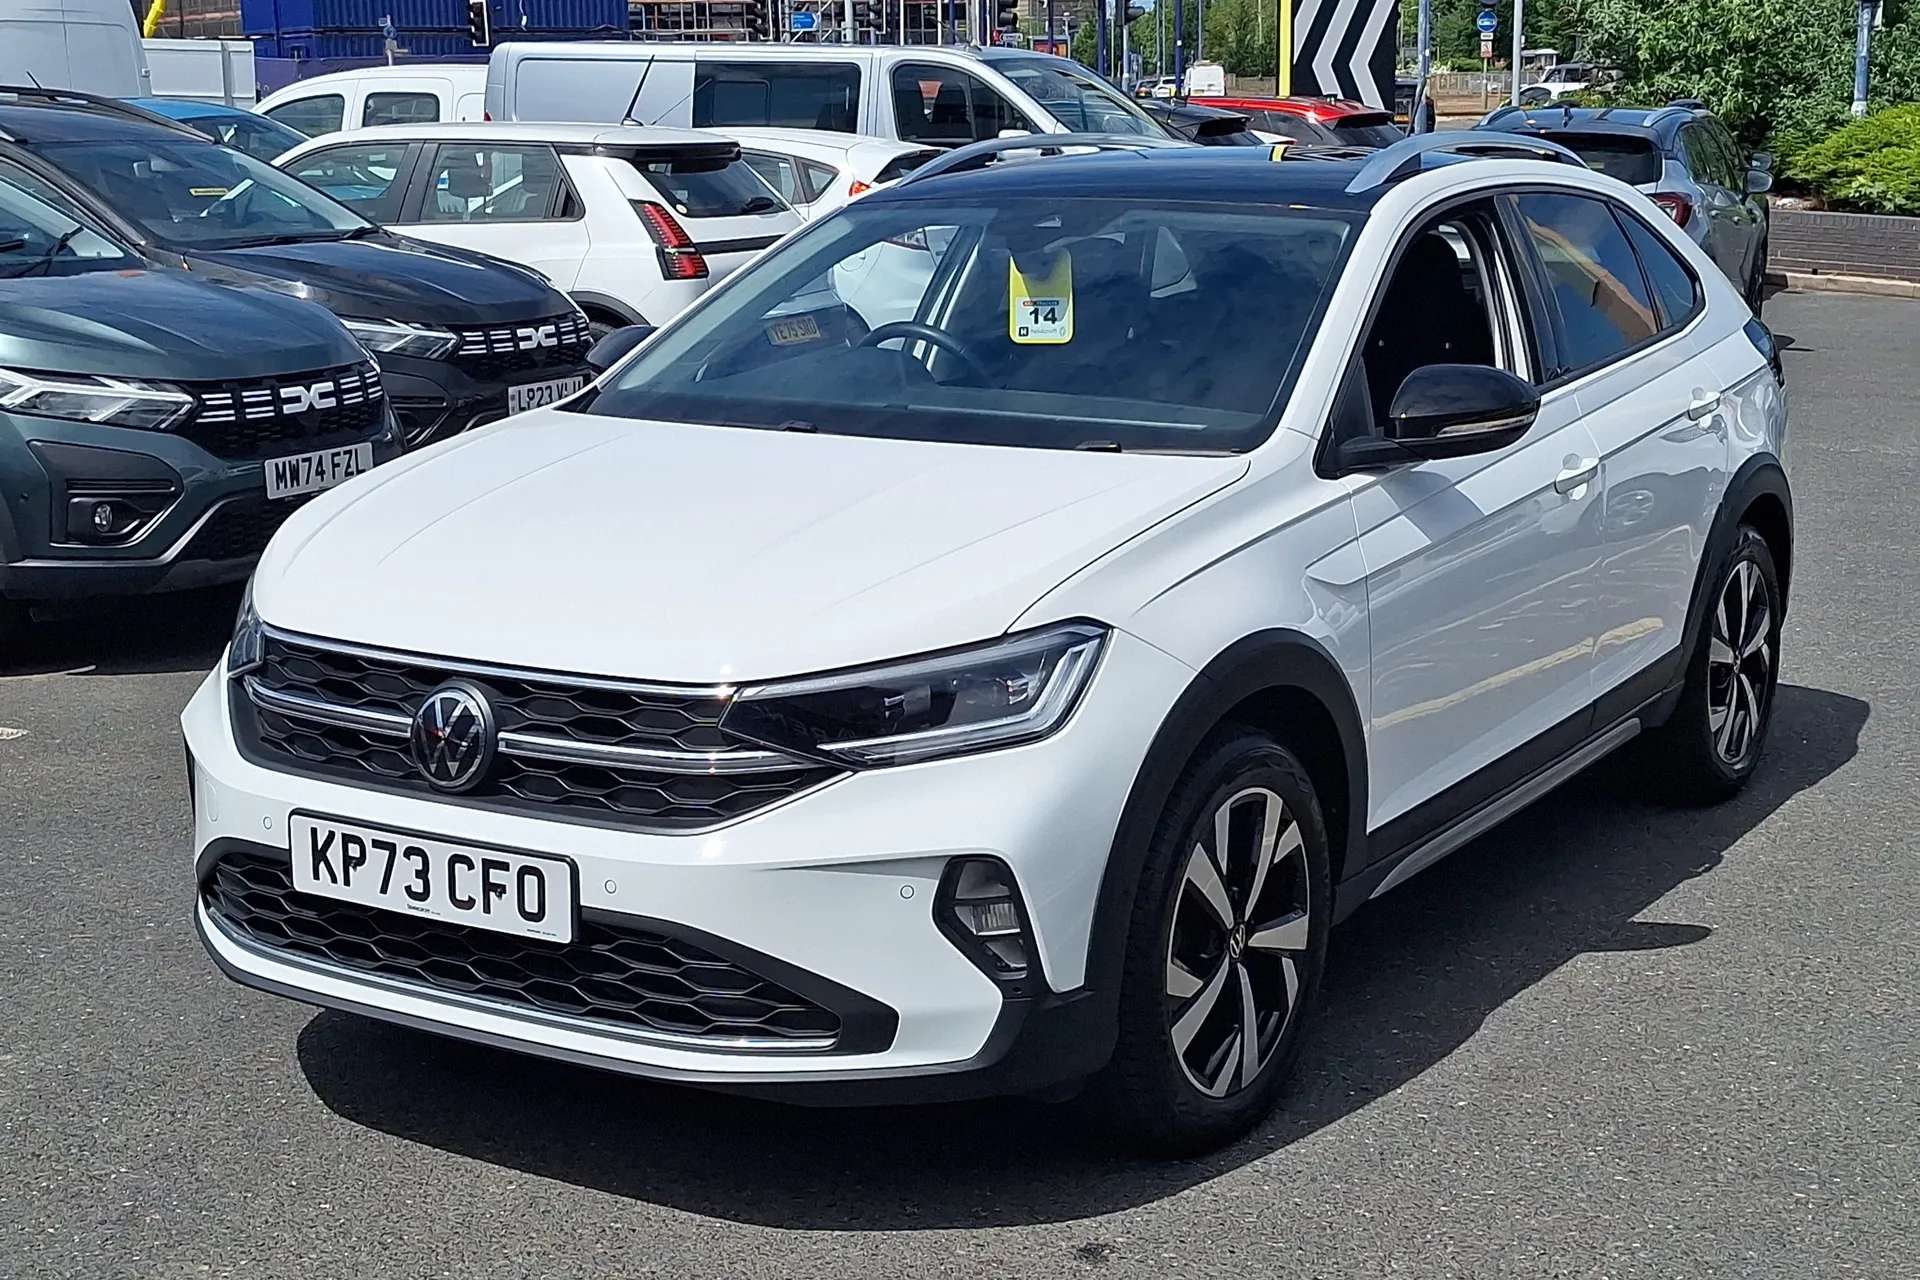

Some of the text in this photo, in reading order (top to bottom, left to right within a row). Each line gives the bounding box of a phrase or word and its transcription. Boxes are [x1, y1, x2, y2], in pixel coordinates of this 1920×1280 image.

[1029, 307, 1058, 325] 14
[518, 384, 553, 411] LP23
[274, 448, 366, 490] MW74 FZL
[309, 826, 546, 923] KP73 CFO
